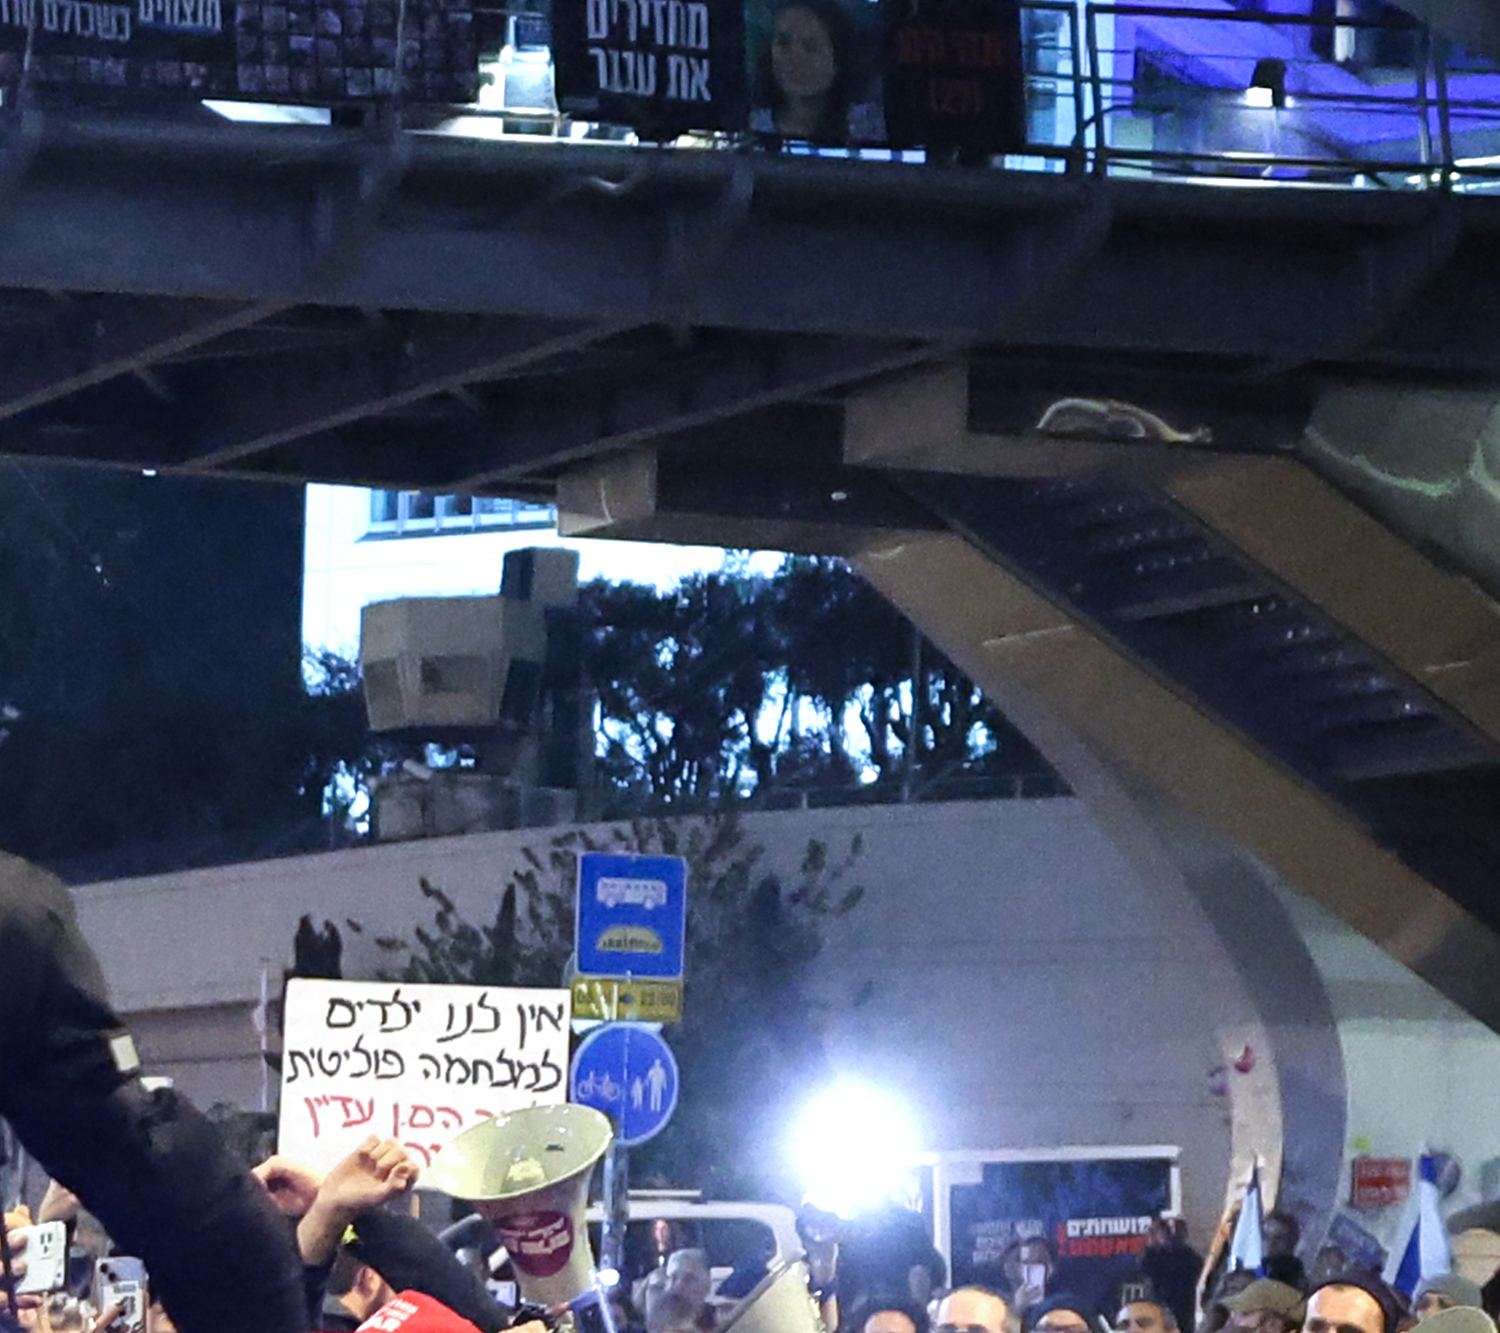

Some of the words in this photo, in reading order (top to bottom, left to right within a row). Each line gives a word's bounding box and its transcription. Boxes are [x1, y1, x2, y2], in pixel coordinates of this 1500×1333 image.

[586, 0, 709, 50] מחזירים
[665, 54, 712, 101] את
[325, 988, 421, 1033] ילדים
[436, 992, 501, 1042] לנו
[517, 1003, 565, 1049] אין
[285, 1034, 405, 1083] פוליטית
[419, 1049, 563, 1092] למלחמה
[303, 1094, 375, 1138] עדיין
